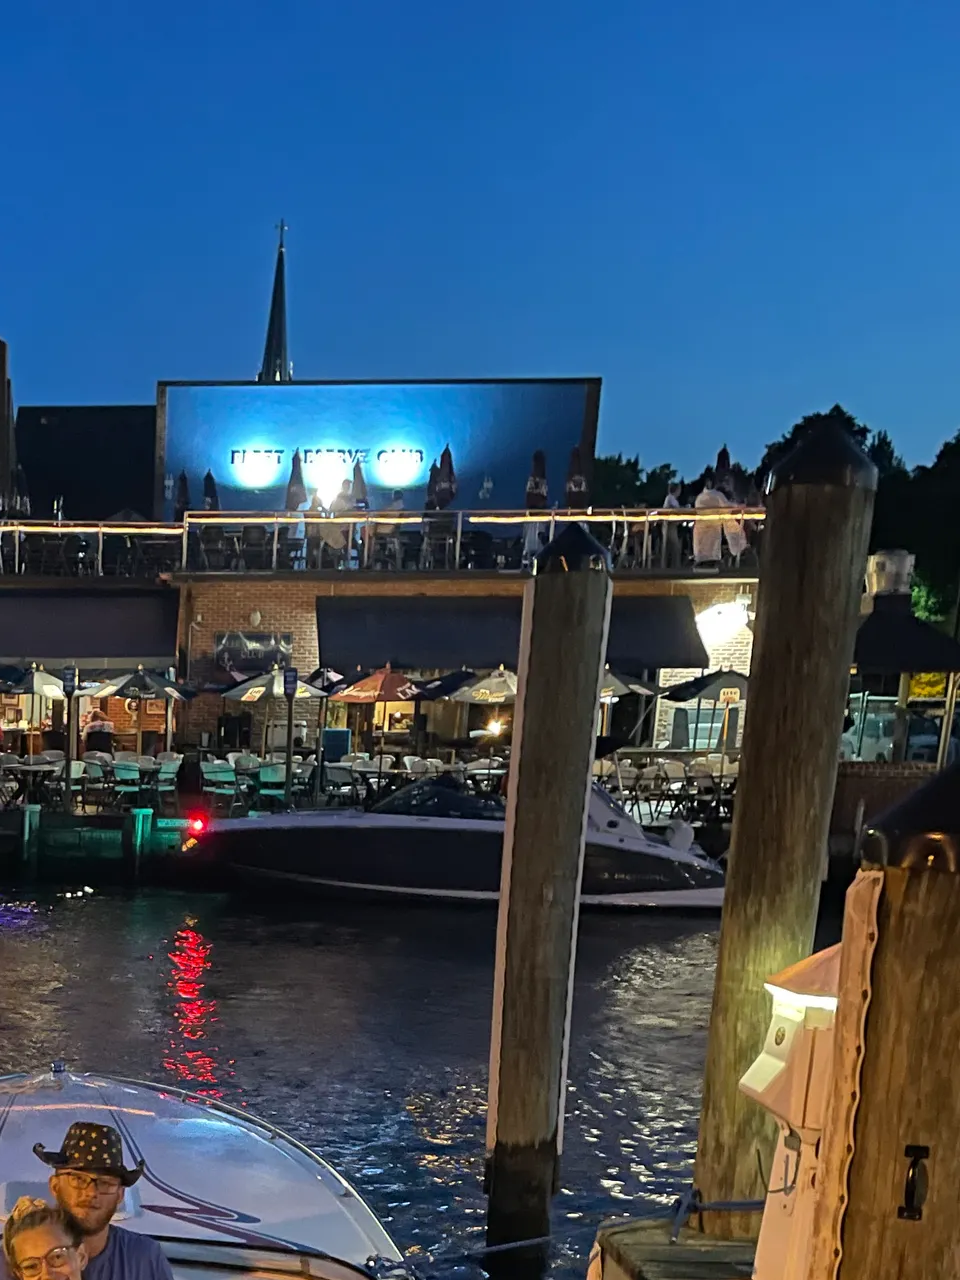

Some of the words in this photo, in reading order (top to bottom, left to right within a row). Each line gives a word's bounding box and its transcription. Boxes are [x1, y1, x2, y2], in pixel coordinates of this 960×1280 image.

[230, 449, 285, 465] FLT
[293, 448, 371, 465] ESRVE
[376, 448, 424, 464] CB
